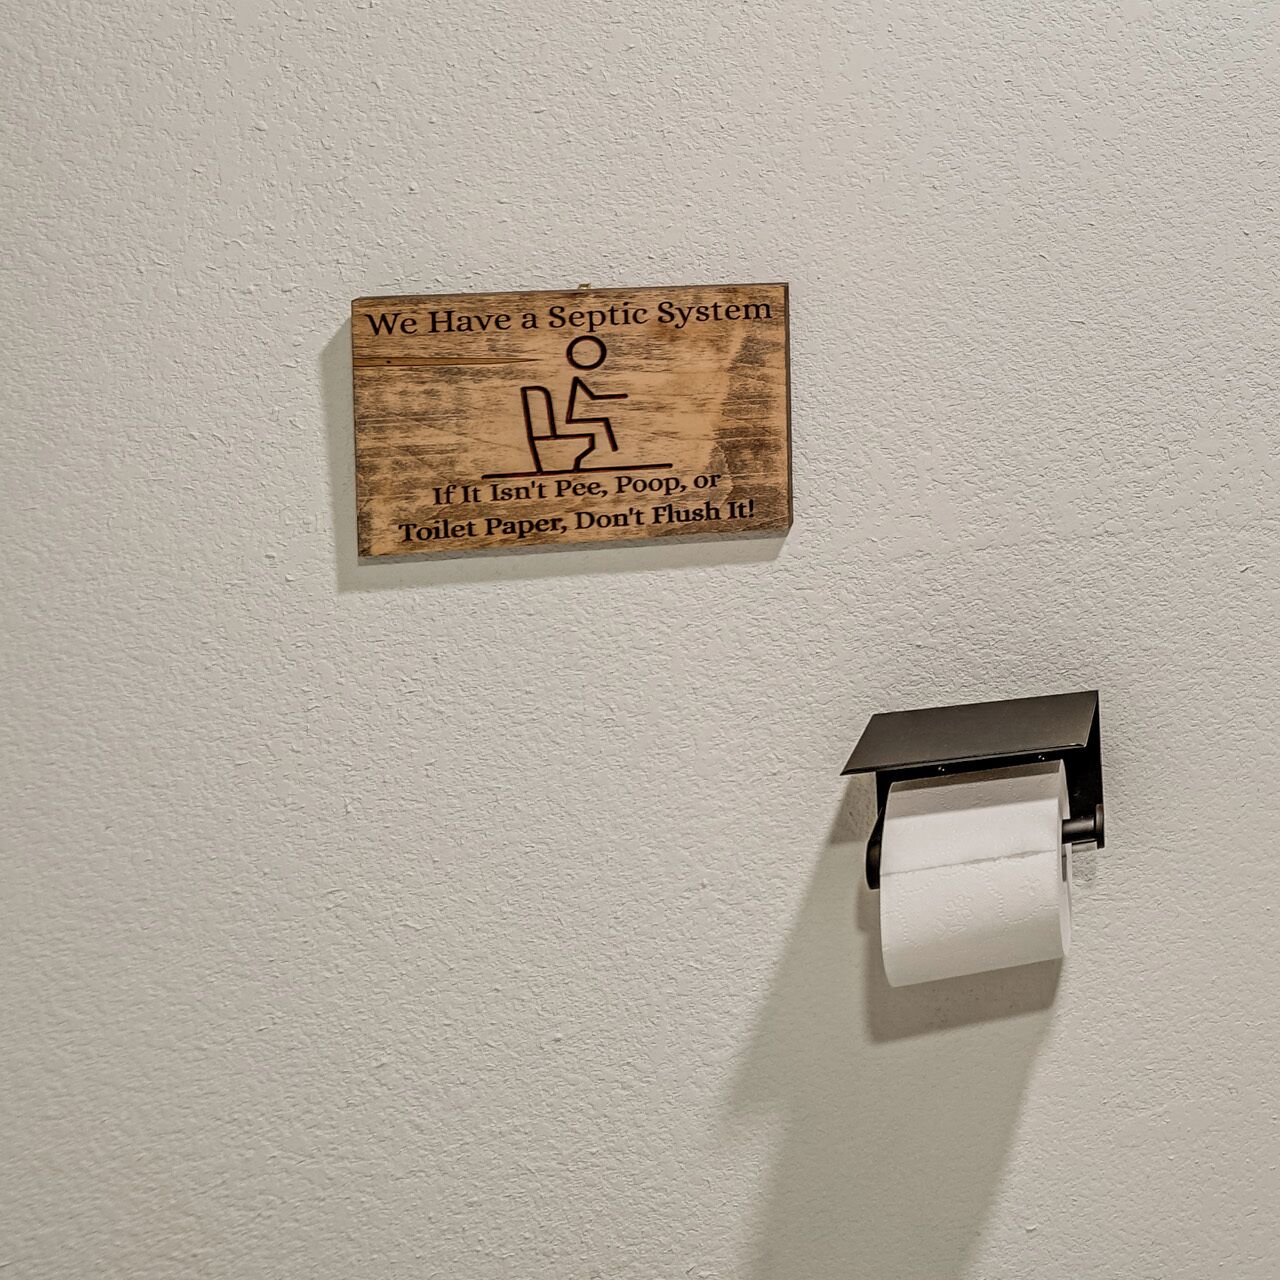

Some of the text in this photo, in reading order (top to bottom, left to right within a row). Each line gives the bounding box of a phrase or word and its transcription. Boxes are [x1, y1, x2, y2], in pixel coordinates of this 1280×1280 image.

[365, 301, 773, 336] We Have a Septic System
[433, 474, 721, 505] If It Isn't Pee, Poop, or
[398, 498, 754, 542] Toilet Paper, Don't Flush It!
